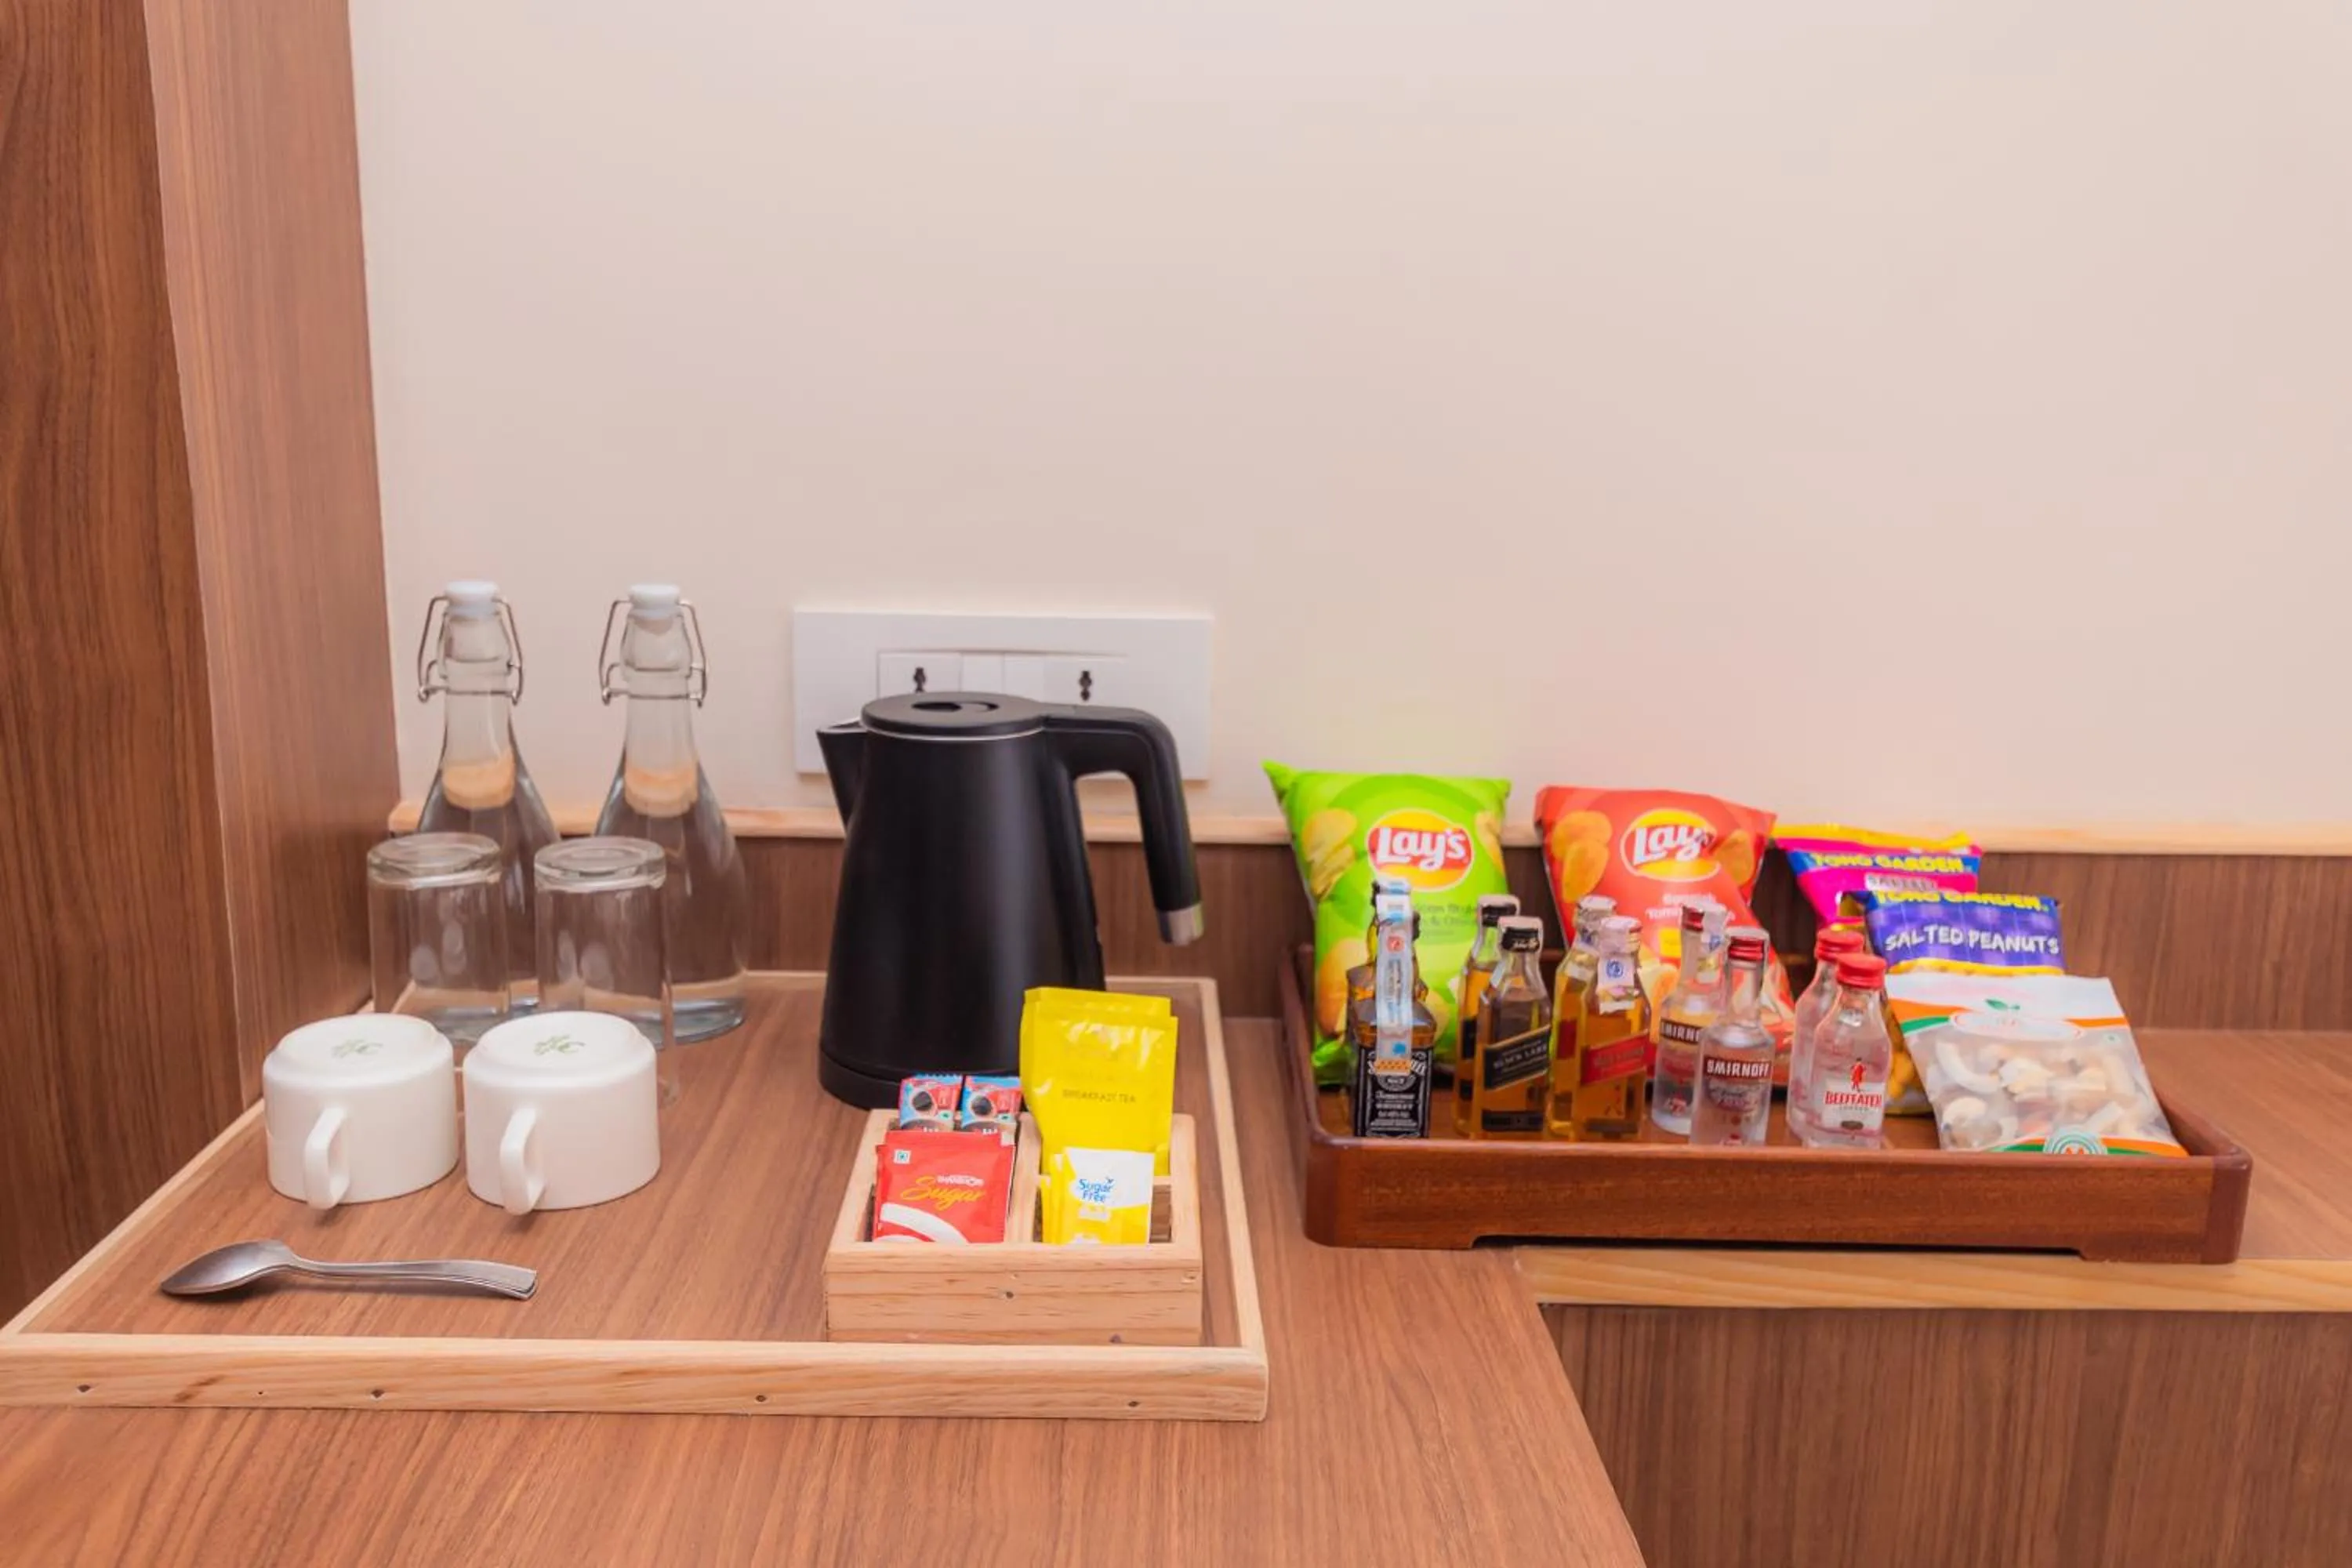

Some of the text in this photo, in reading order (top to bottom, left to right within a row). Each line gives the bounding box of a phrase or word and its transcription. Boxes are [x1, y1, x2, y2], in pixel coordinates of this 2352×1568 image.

[1377, 827, 1466, 872] Lay's
[1633, 826, 1715, 866] Lay
[1875, 855, 1964, 873] GARDEN
[1886, 924, 2060, 954] SALTED PEANUTS
[1706, 1059, 1769, 1077] SMIRNOFF
[900, 1175, 985, 1211] Sugar
[1078, 1178, 1114, 1192] Sugar
[1083, 1190, 1105, 1202] Free
